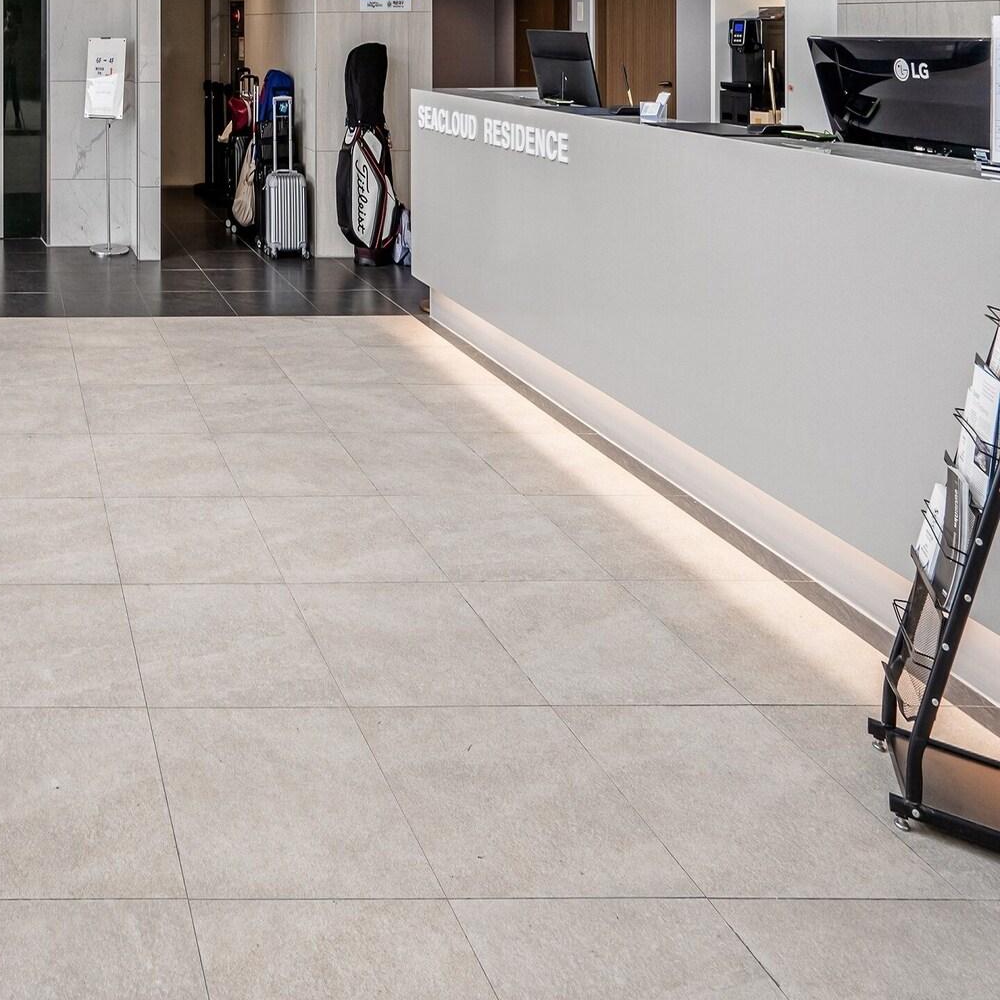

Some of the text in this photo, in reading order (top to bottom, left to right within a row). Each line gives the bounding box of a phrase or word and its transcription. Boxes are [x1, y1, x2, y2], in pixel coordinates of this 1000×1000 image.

[418, 105, 569, 164] SEACLOUD RESIDENCE
[355, 159, 370, 235] Titleist
